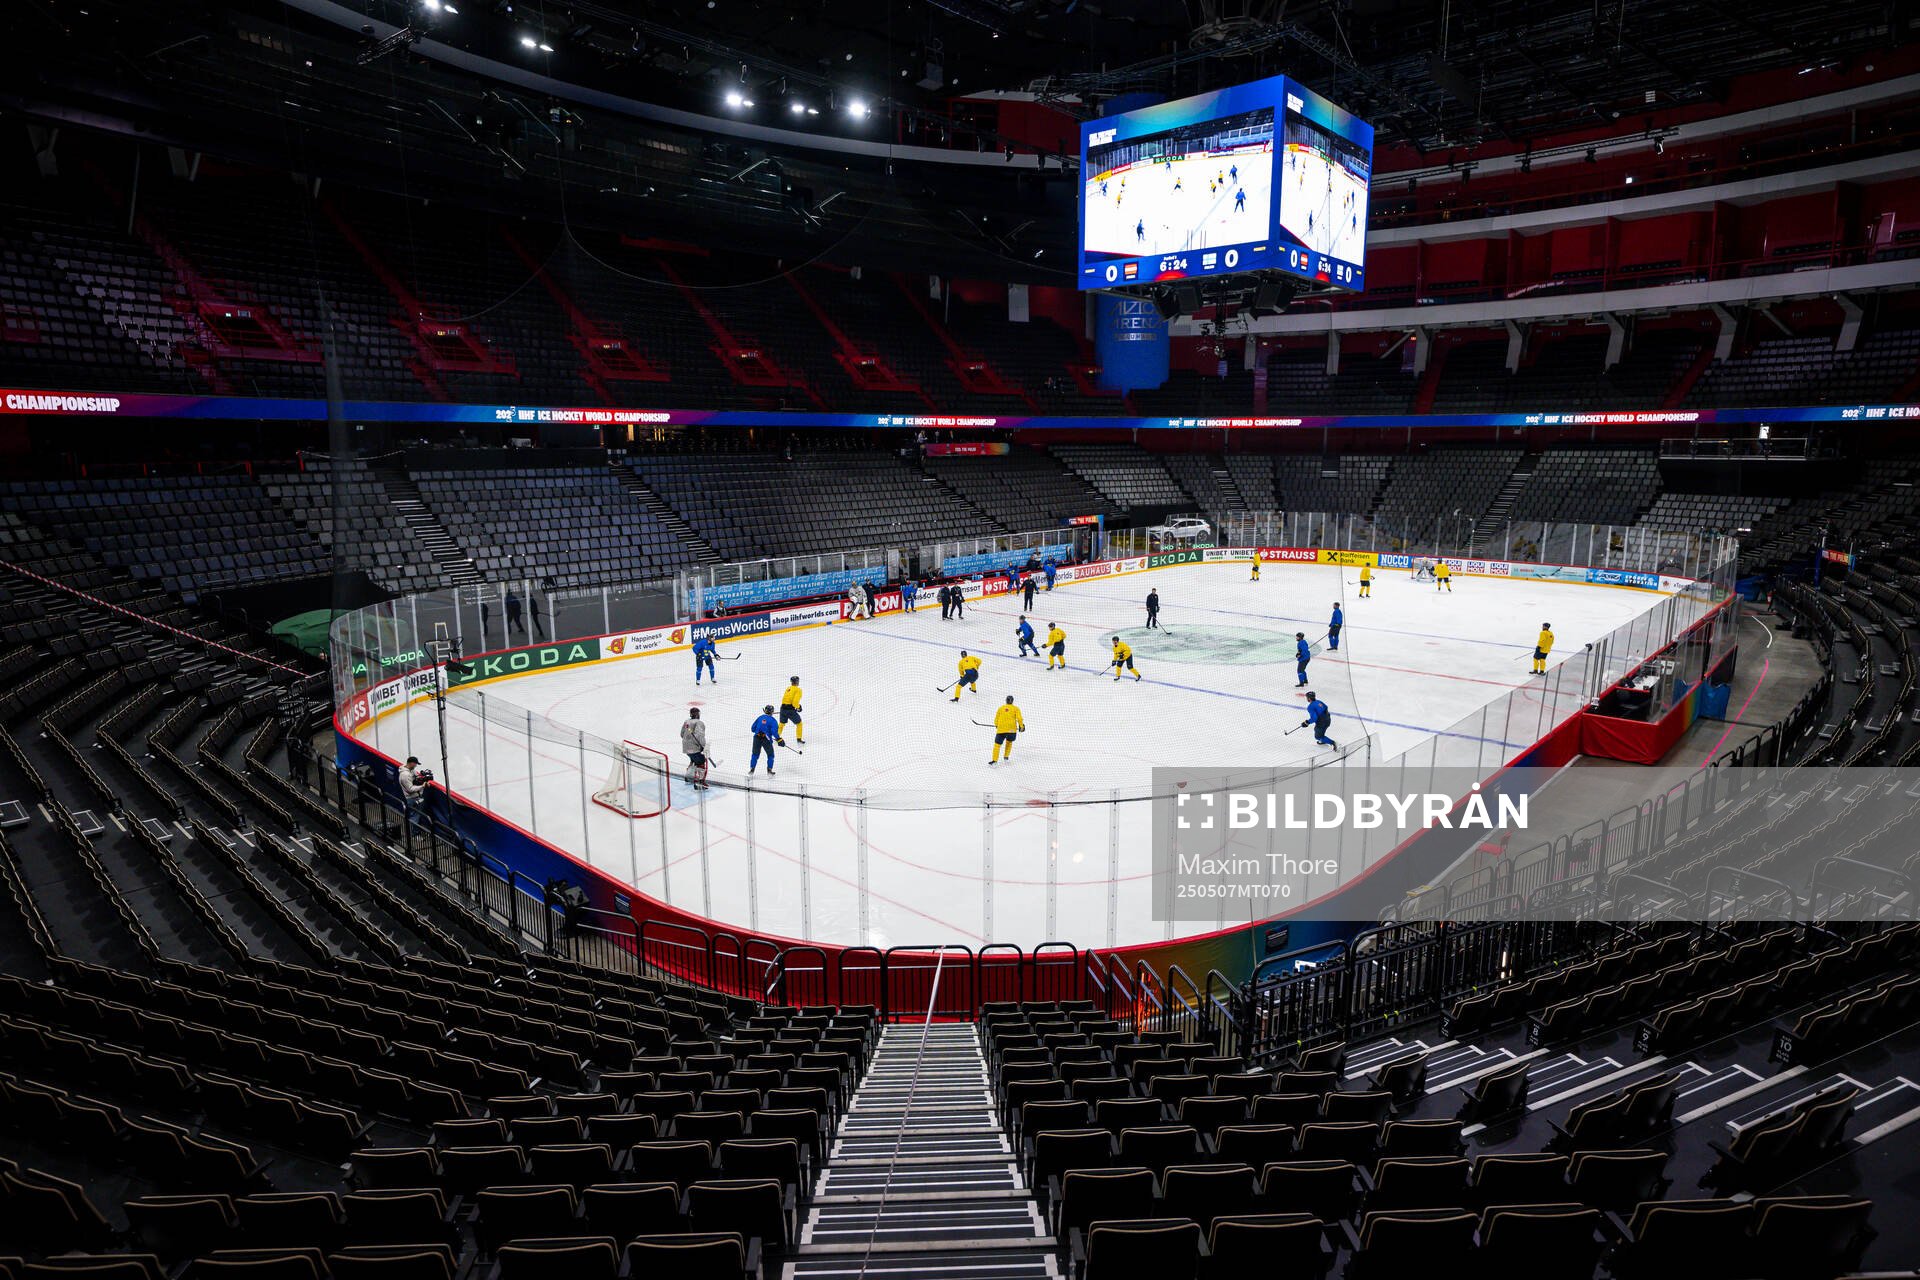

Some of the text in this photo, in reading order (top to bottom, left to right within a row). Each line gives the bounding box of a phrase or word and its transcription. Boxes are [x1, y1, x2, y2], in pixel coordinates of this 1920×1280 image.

[1224, 249, 1239, 268] 0
[1290, 249, 1298, 268] 0
[1159, 259, 1188, 272] 6:24
[1105, 265, 1118, 282] 0
[1345, 266, 1352, 283] 0
[6, 394, 120, 412] CHAMPIONSHIP
[538, 410, 551, 420] ICE
[552, 410, 585, 421] HOCKEY
[585, 411, 612, 421] WORLD
[614, 411, 670, 422] CHAMPIONSHIP
[1561, 415, 1574, 423] ICE
[1575, 414, 1606, 423] HOCKEY
[1607, 414, 1635, 422] WORLD
[1636, 413, 1699, 422] CHAMPIONSHIP
[1866, 408, 1886, 417] IIHF
[1888, 408, 1905, 417] ICE
[915, 417, 936, 425] HOCKEY
[937, 417, 956, 425] WORLD
[957, 418, 996, 426] CHAMPIONSHIP
[1207, 419, 1231, 427] HOCKEY
[1232, 419, 1253, 427] WORLD
[1254, 418, 1302, 427] CHAMPIONSHIP
[1151, 551, 1198, 566] SKODA
[1269, 550, 1316, 560] STRAUSS
[1381, 554, 1409, 565] NOCCO
[1075, 564, 1111, 579] BAUHAUS
[693, 618, 769, 640] #MensWorlds
[631, 633, 662, 643] Happiness
[1780, 1039, 1792, 1052] 10
